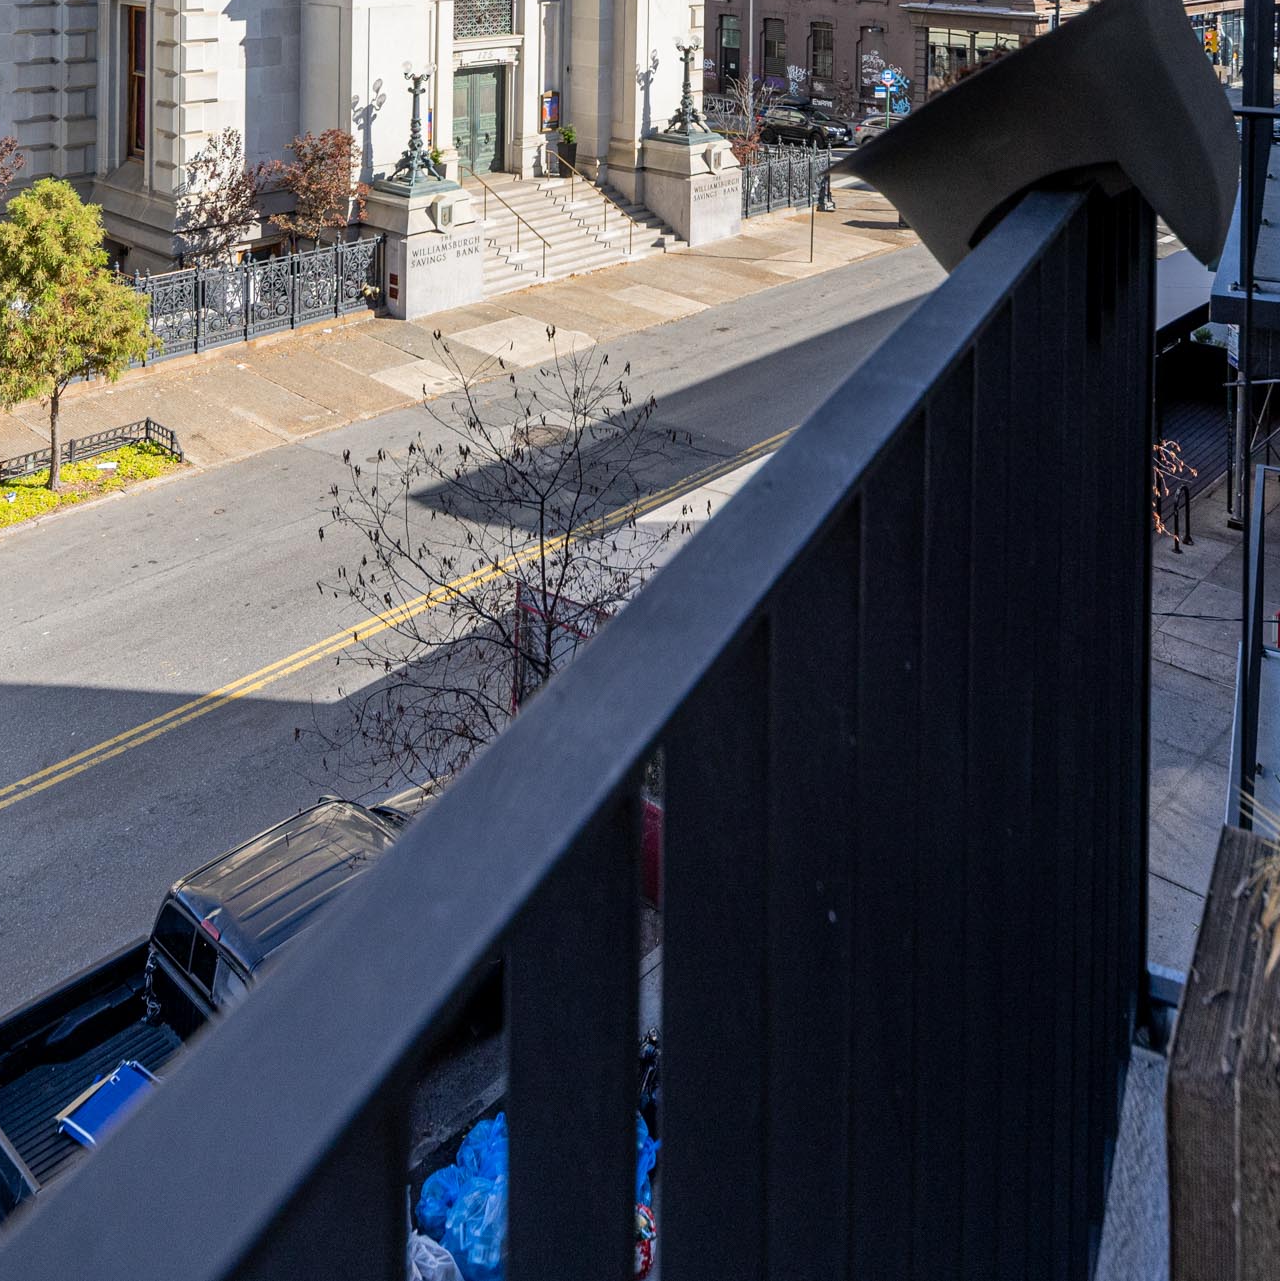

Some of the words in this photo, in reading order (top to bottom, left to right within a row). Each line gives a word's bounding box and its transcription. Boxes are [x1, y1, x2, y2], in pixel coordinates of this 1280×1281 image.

[478, 51, 494, 59] 175
[694, 178, 739, 193] WILLIAMSBURGH
[694, 192, 717, 201] SAVINGS
[723, 186, 739, 195] BANK
[441, 234, 452, 242] THE
[411, 235, 480, 258] WILLIAMSBURGH
[410, 253, 447, 268] SAVINGS
[456, 245, 480, 258] BANK
